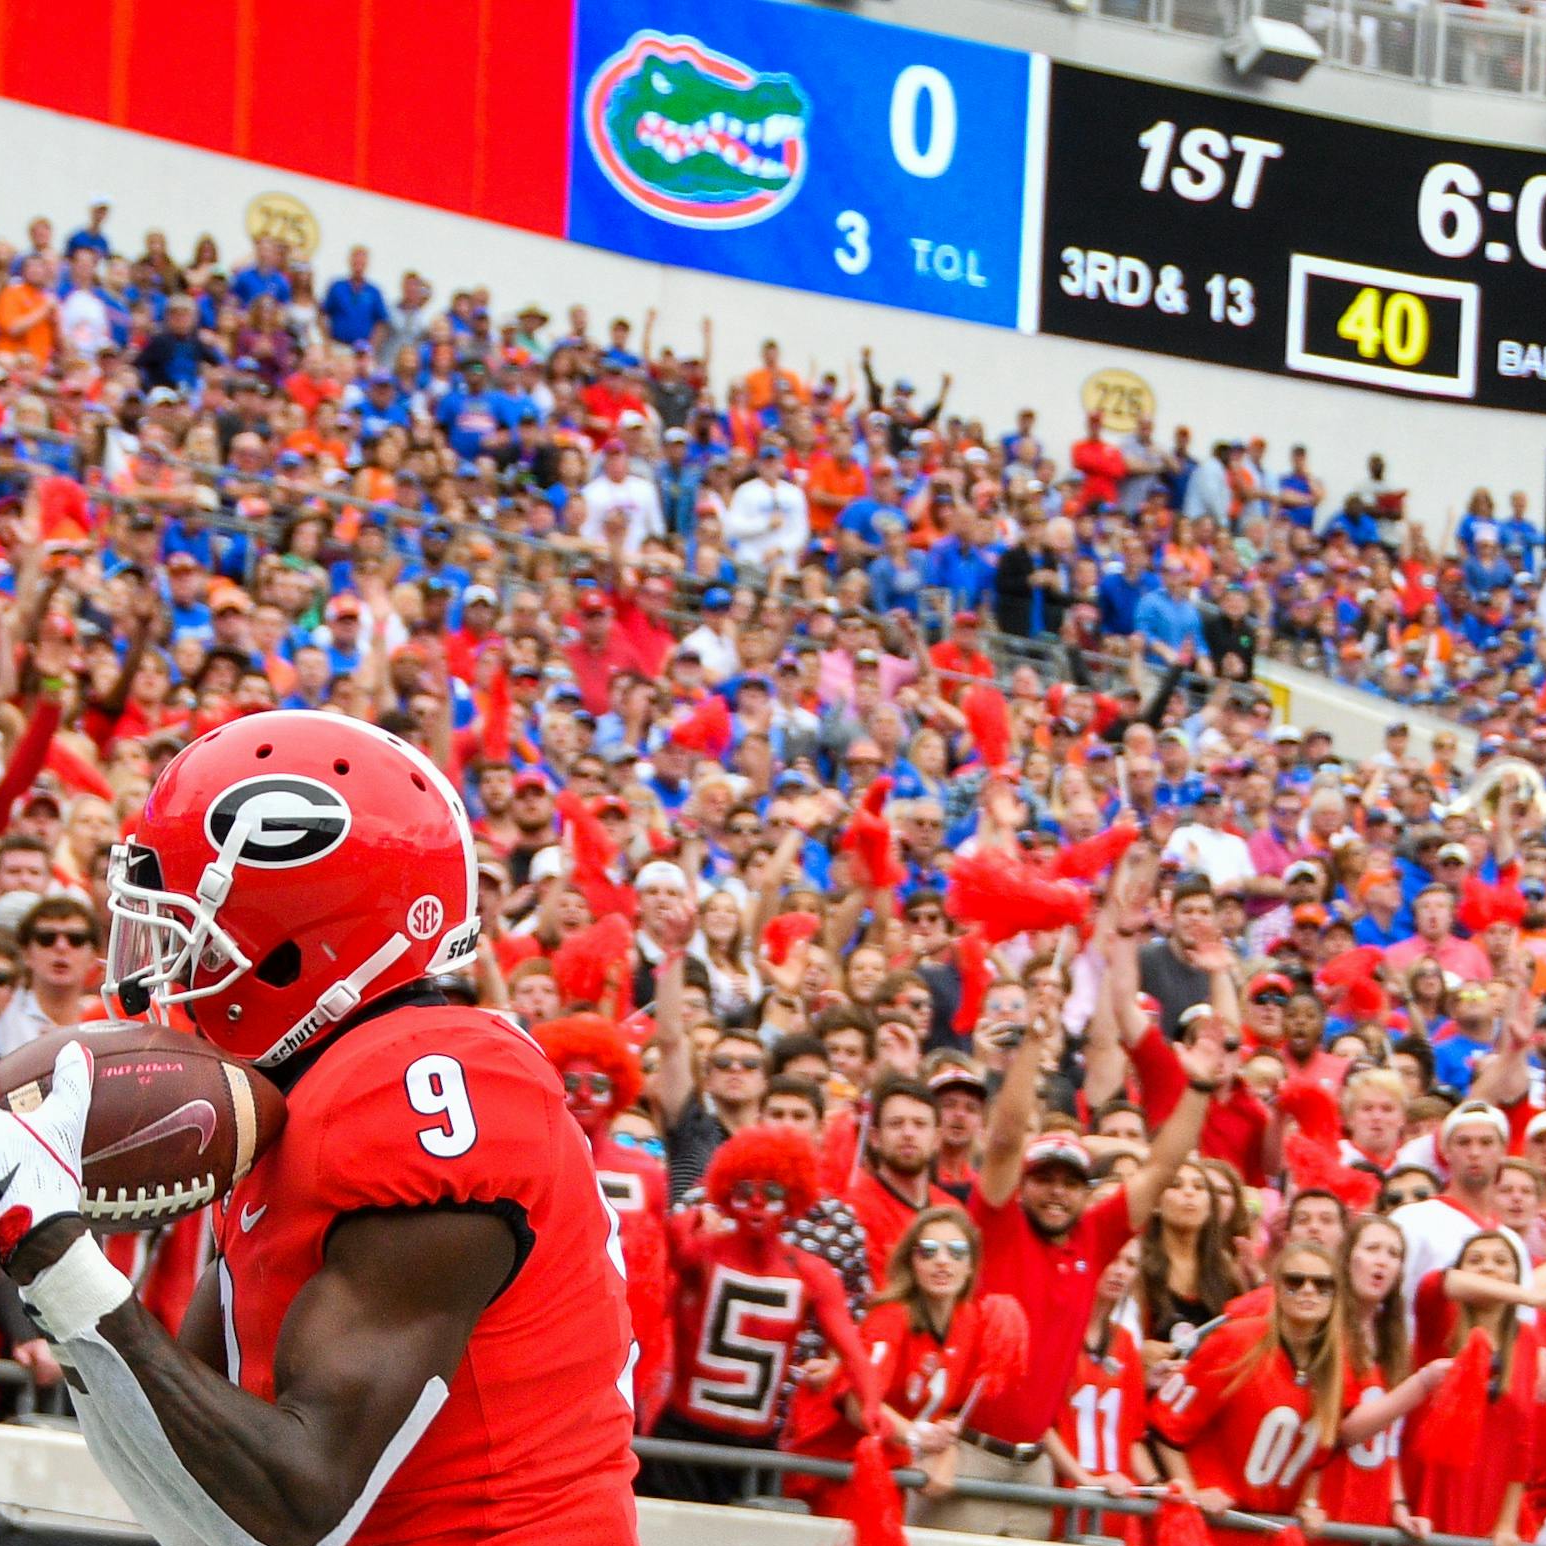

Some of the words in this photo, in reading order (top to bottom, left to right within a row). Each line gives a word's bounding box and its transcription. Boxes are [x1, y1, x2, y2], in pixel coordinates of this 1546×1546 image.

[889, 64, 958, 179] 0
[1138, 120, 1284, 209] 1ST
[834, 209, 871, 276] 3
[1059, 246, 1152, 307] 3RD
[1154, 264, 1189, 315] &
[1205, 273, 1256, 327] 13
[1337, 287, 1430, 366] 40
[412, 900, 439, 934] SEC
[270, 1016, 321, 1063] schutt
[405, 1055, 477, 1158] 9
[689, 1266, 803, 1424] 5
[1070, 1384, 1122, 1472] 11
